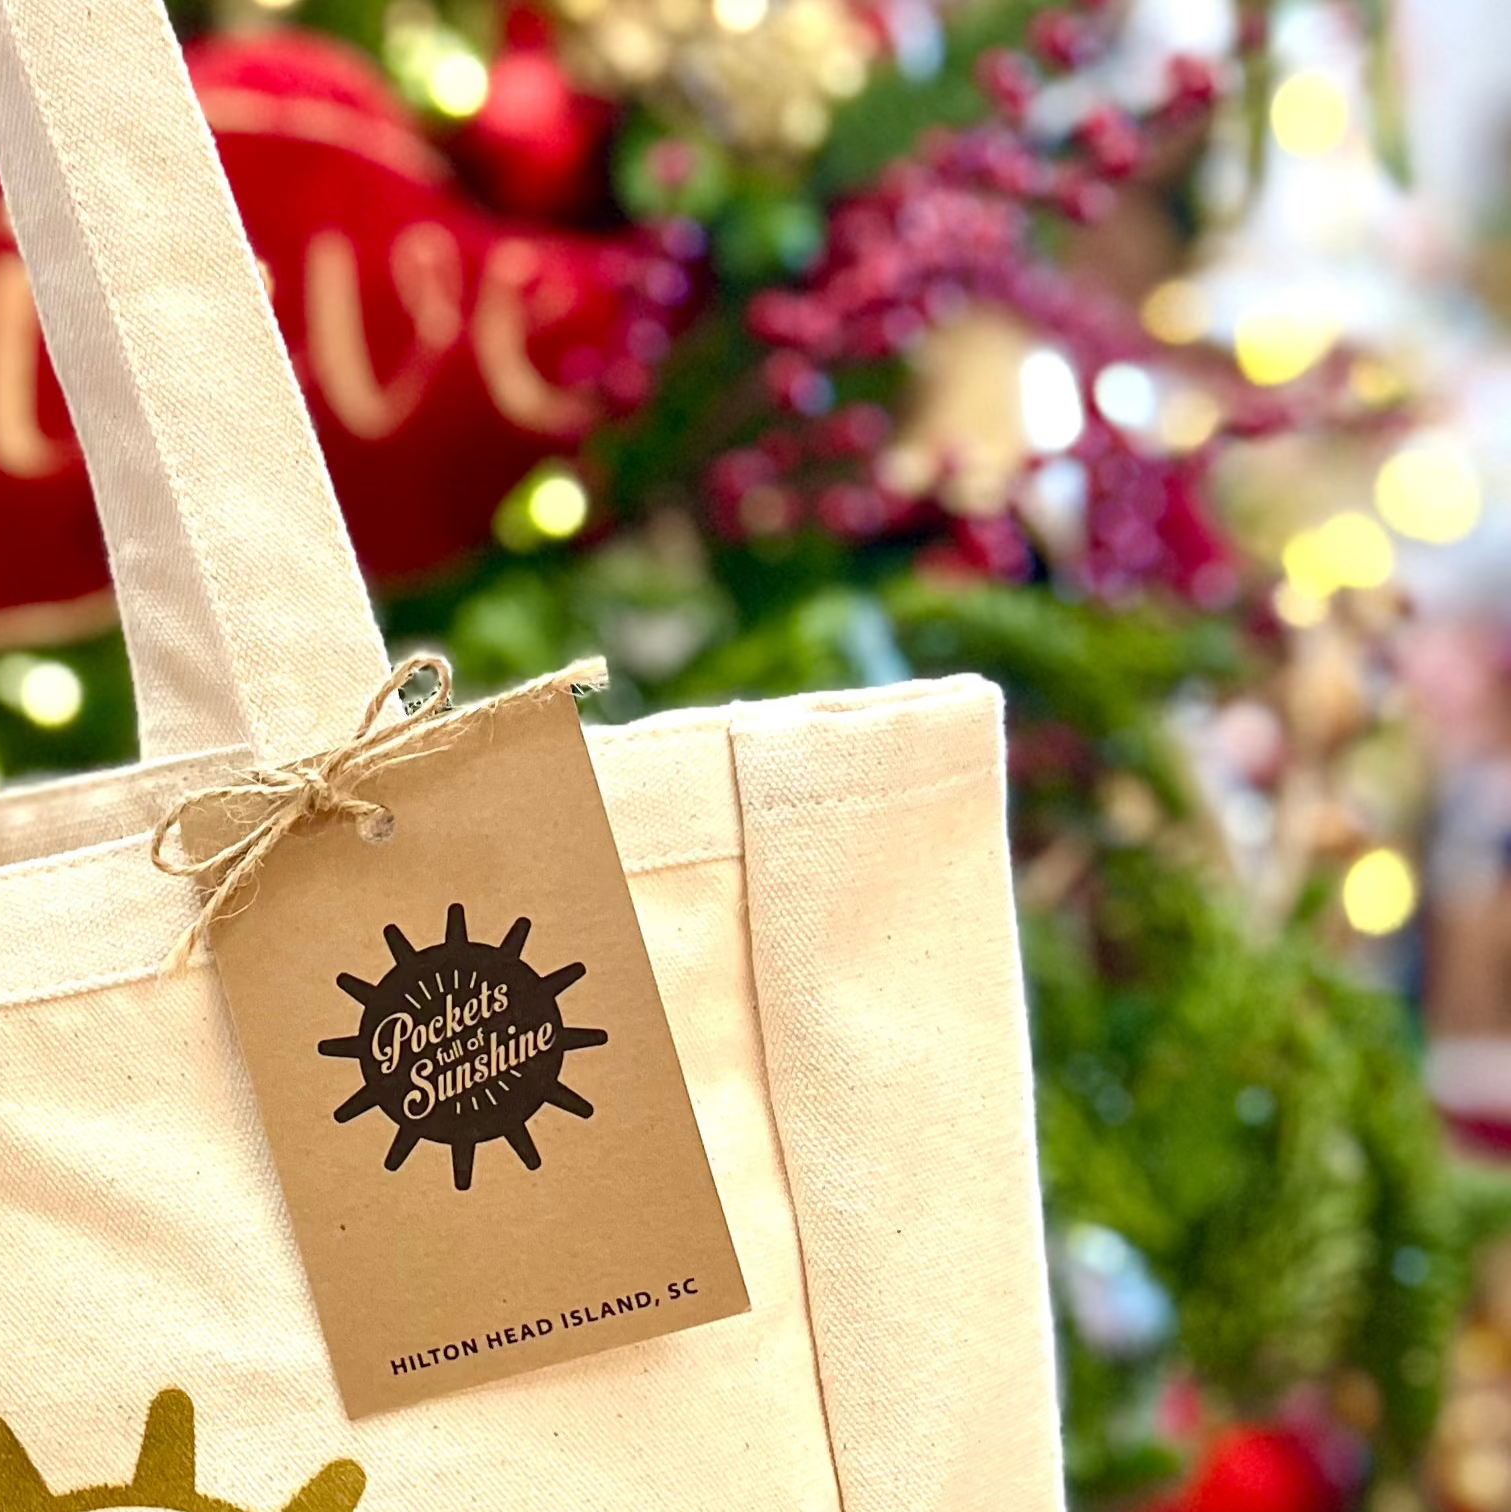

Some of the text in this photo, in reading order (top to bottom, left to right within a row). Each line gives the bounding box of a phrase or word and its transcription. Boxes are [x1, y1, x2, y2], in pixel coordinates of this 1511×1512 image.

[372, 981, 508, 1074] Pockets
[403, 1021, 554, 1120] Sunshine
[436, 1027, 486, 1066] full of
[390, 1278, 699, 1375] HILTON HEAD ISLAND, SC
